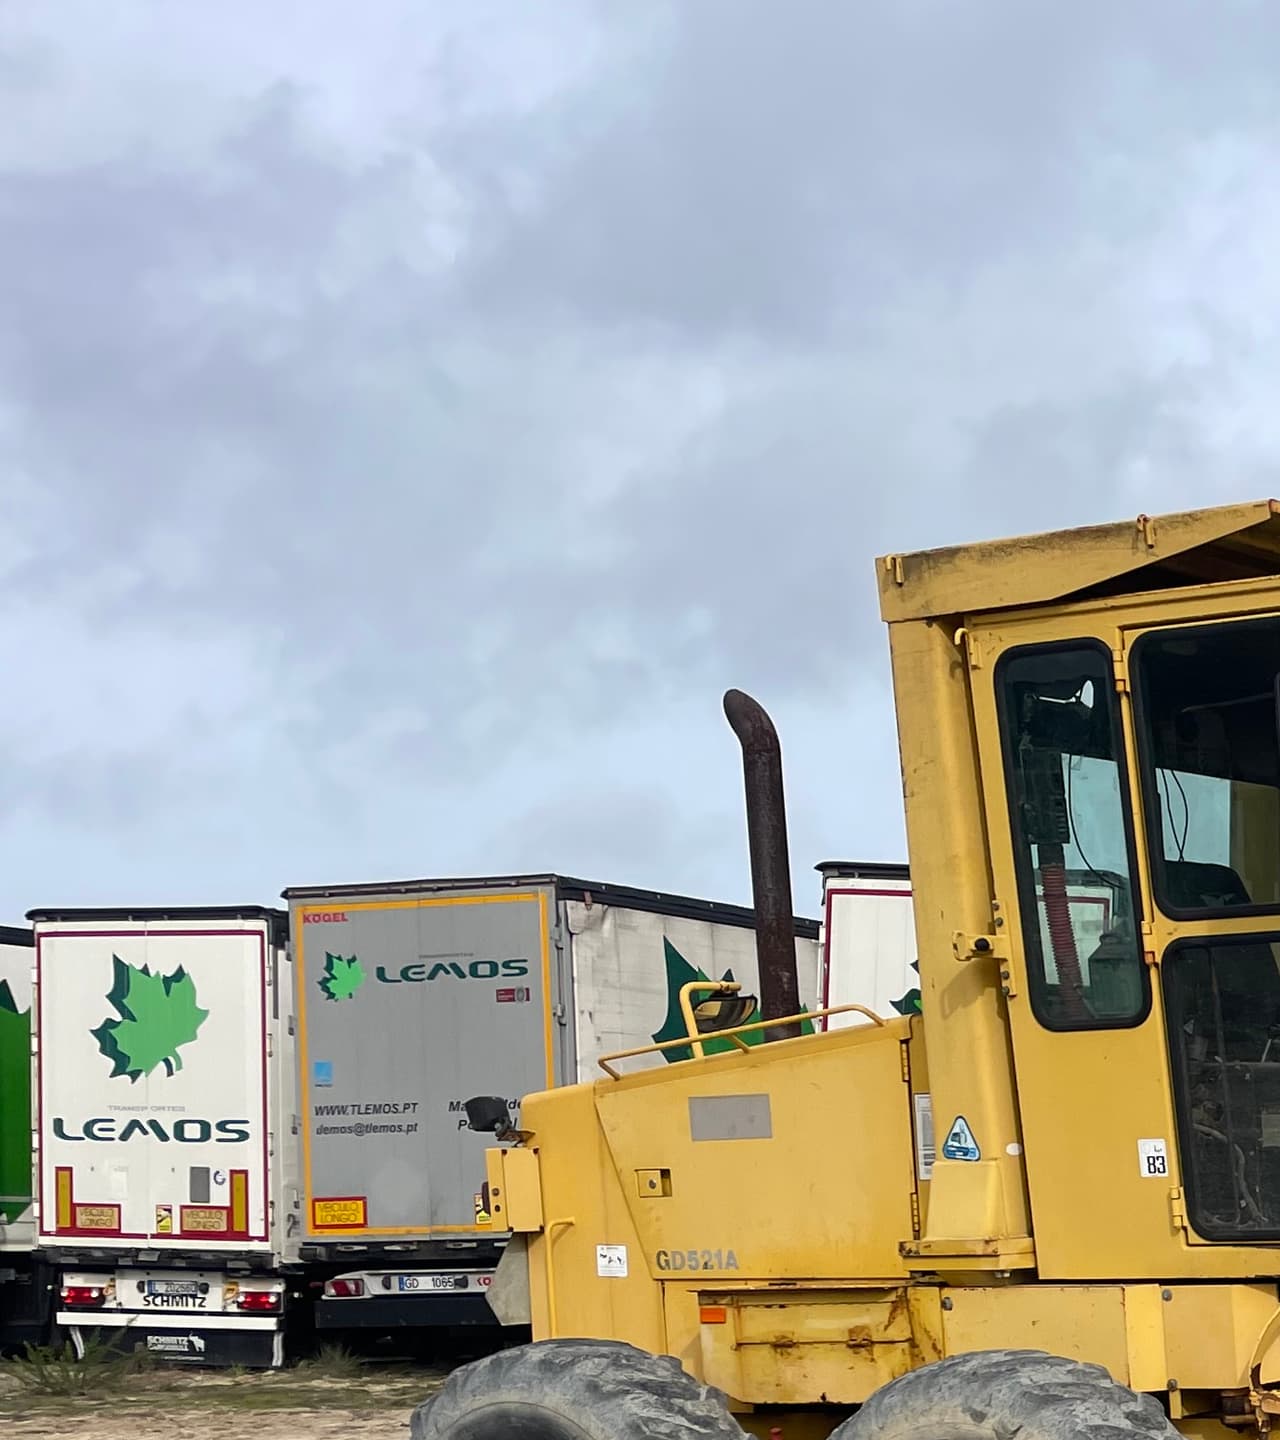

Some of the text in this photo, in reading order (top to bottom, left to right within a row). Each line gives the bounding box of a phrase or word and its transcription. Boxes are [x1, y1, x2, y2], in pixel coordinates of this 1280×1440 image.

[375, 958, 530, 984] LEMOS
[314, 1102, 419, 1117] WWW.TLEMOS.PT
[52, 1117, 251, 1143] LEMOS
[1146, 1155, 1167, 1174] 83
[655, 1249, 740, 1271] GD521A
[404, 1279, 419, 1289] GD
[143, 1294, 207, 1308] SCHMITZ
